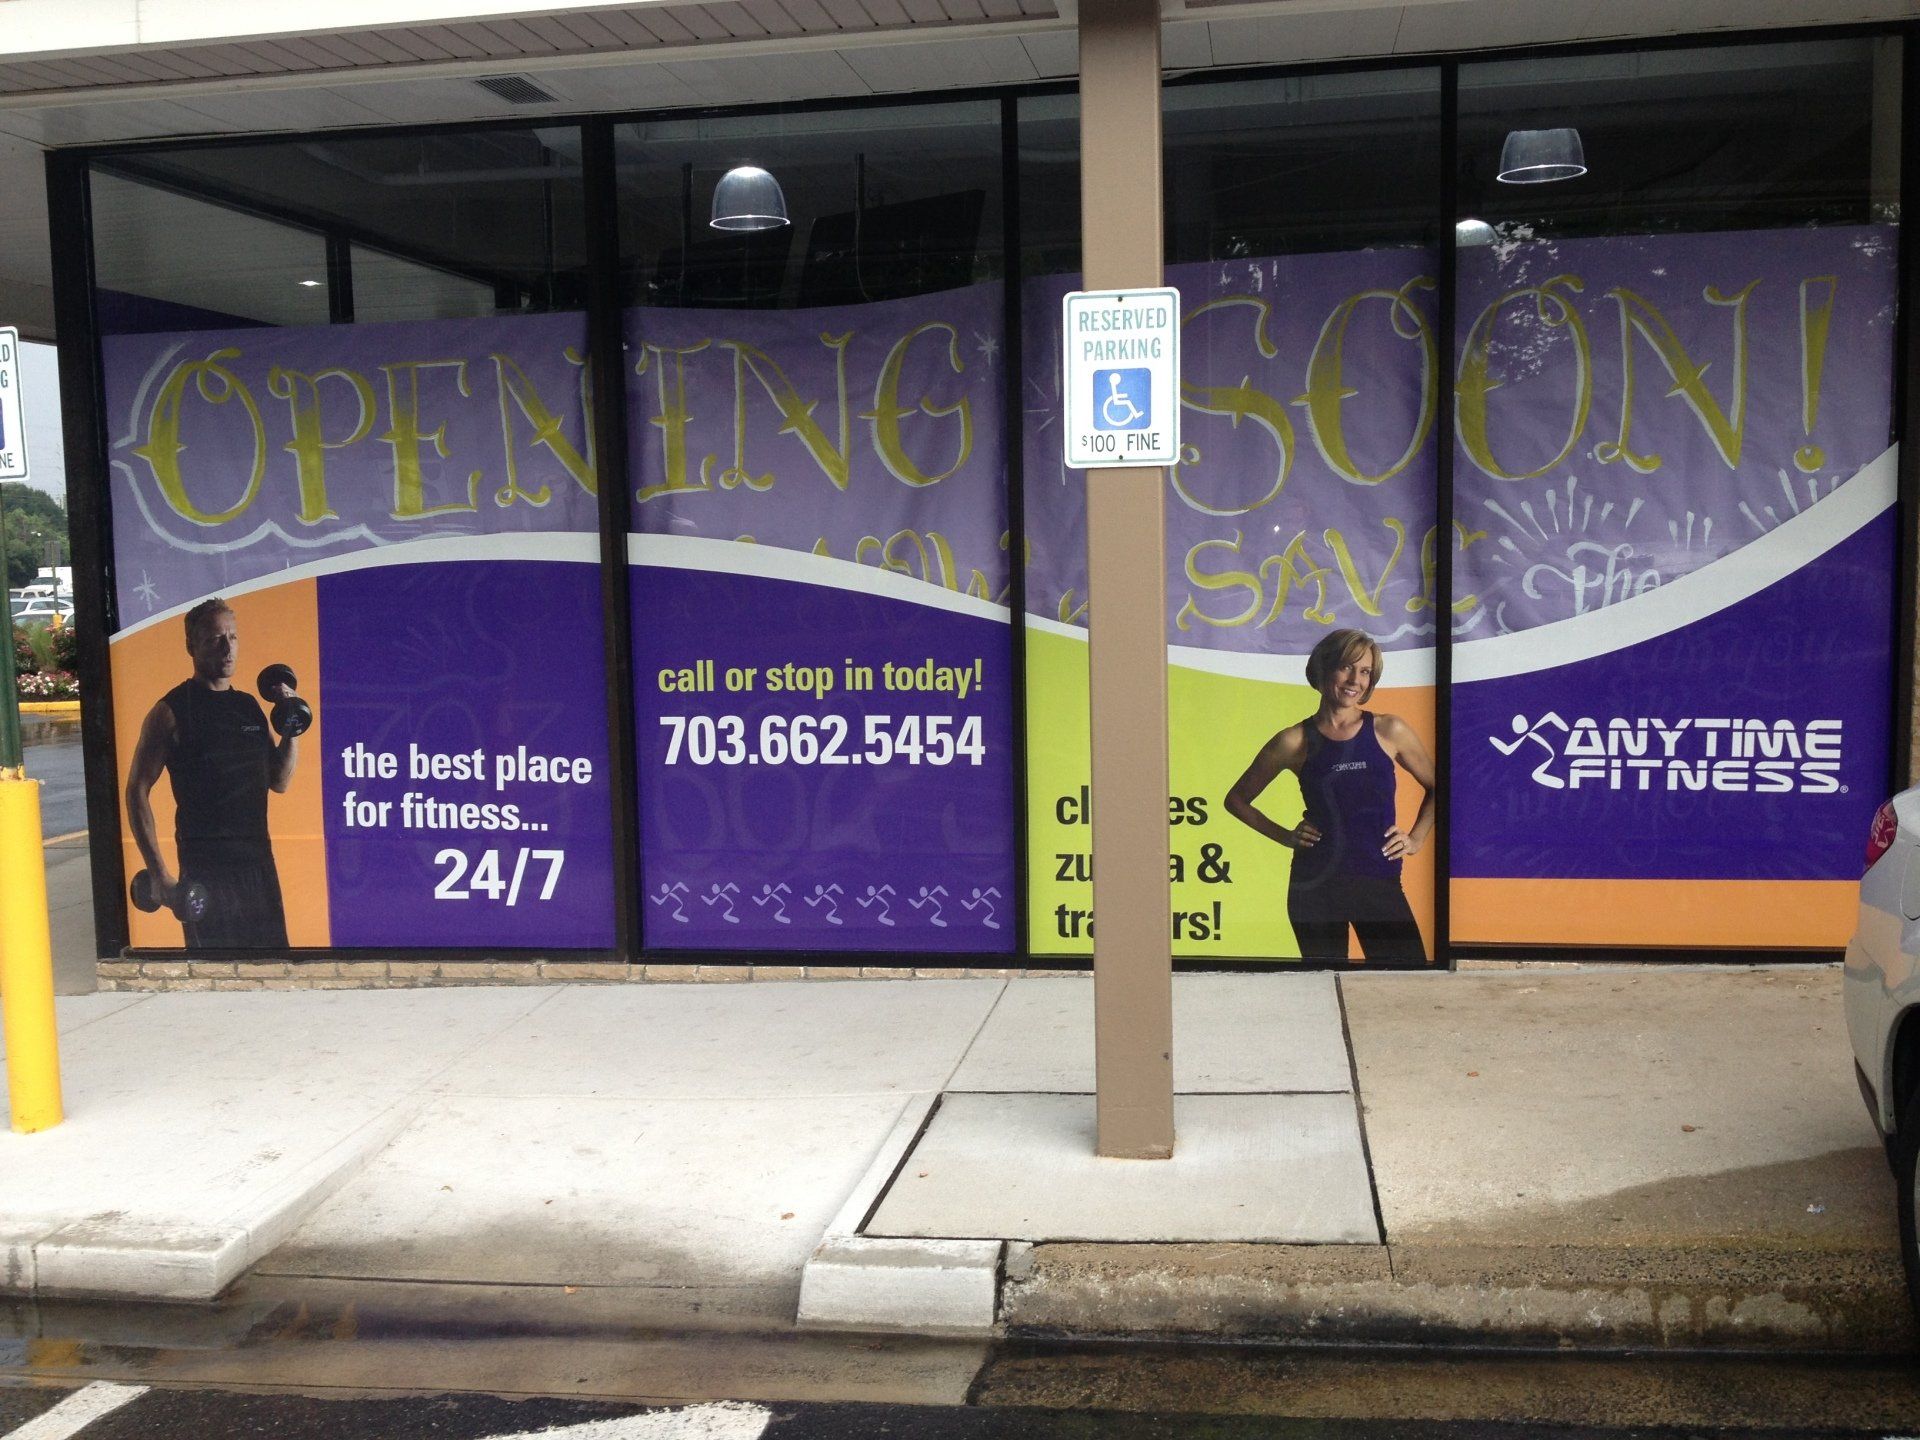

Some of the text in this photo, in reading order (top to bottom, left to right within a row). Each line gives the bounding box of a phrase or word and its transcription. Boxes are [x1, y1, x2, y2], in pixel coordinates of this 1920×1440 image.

[1079, 307, 1167, 332] RESERVED
[1083, 337, 1162, 361] PARKING
[132, 320, 972, 526] OPENING
[1082, 433, 1161, 452] $100 FINE
[658, 658, 982, 699] call or stop in today!
[659, 715, 986, 765] 703.662.5454
[1564, 717, 1843, 758] ANYTIME
[341, 742, 593, 791] the best place
[343, 791, 549, 832] for fitness...
[1056, 785, 1209, 826] cles
[434, 847, 565, 906] 24/7
[1197, 842, 1233, 884] &
